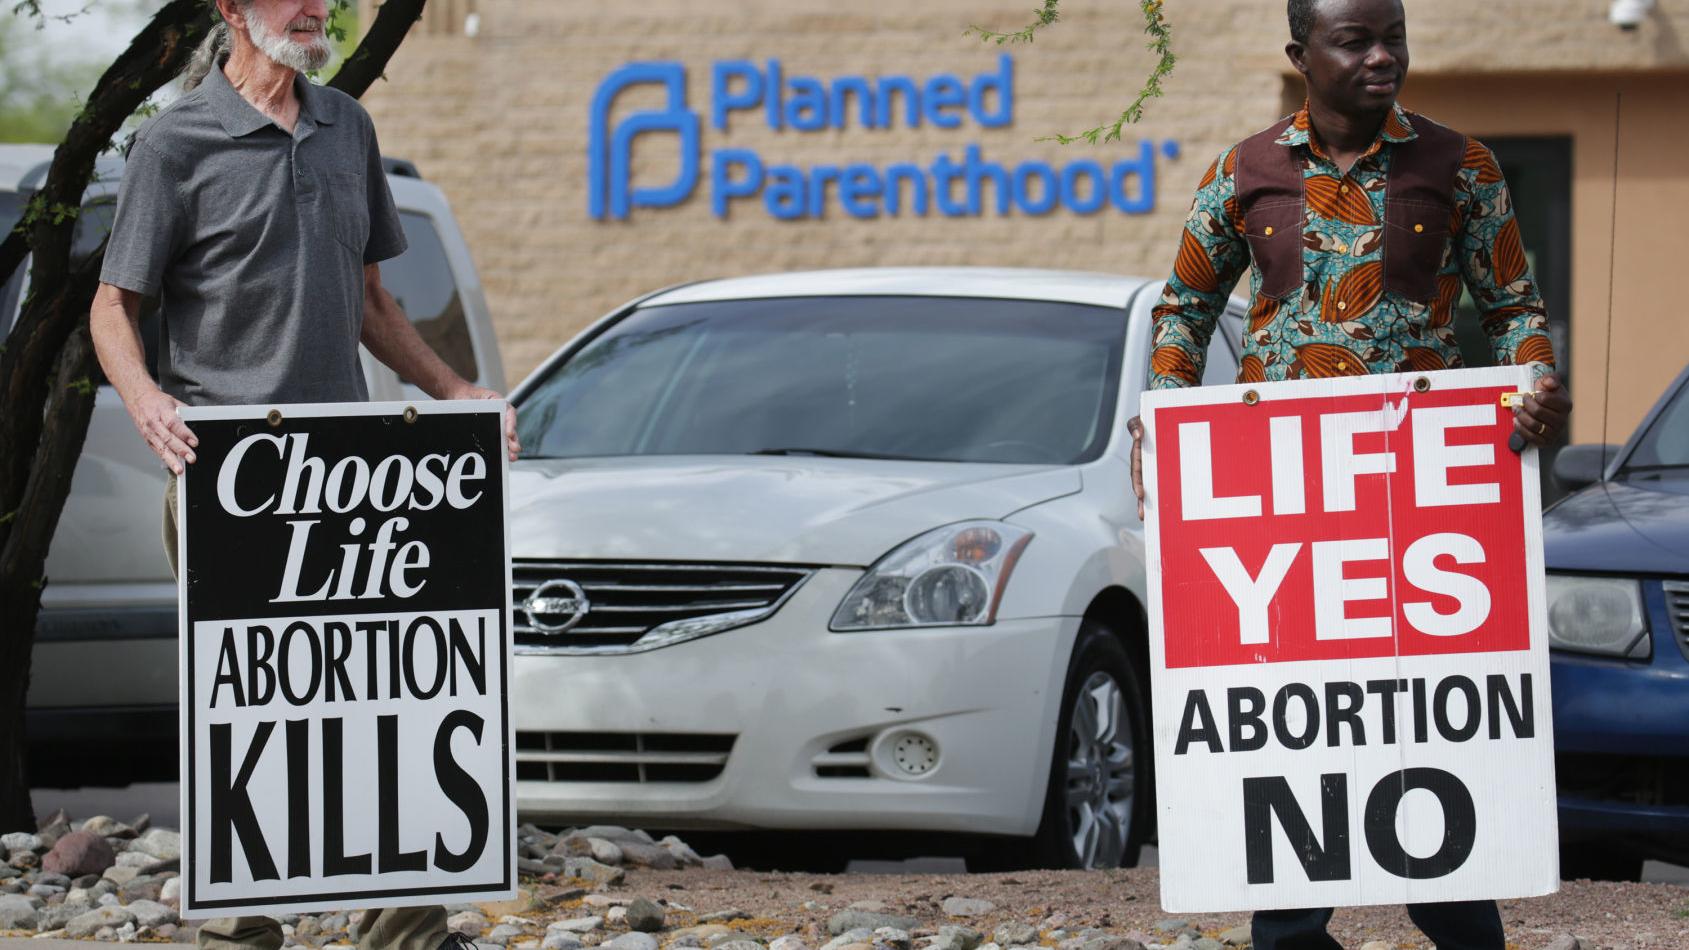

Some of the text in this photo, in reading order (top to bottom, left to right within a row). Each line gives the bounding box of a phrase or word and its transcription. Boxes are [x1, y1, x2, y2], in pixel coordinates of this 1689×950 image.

[711, 53, 1015, 132] Planned
[711, 140, 1156, 219] Parenthood
[216, 433, 487, 517] Choose
[1178, 404, 1500, 521] LIFE
[269, 516, 430, 604] Life
[1198, 532, 1492, 645] YES
[209, 615, 487, 709] ABORTION
[1174, 673, 1535, 756] ABORTION
[209, 709, 489, 885] KILLS
[1243, 767, 1477, 885] NO
